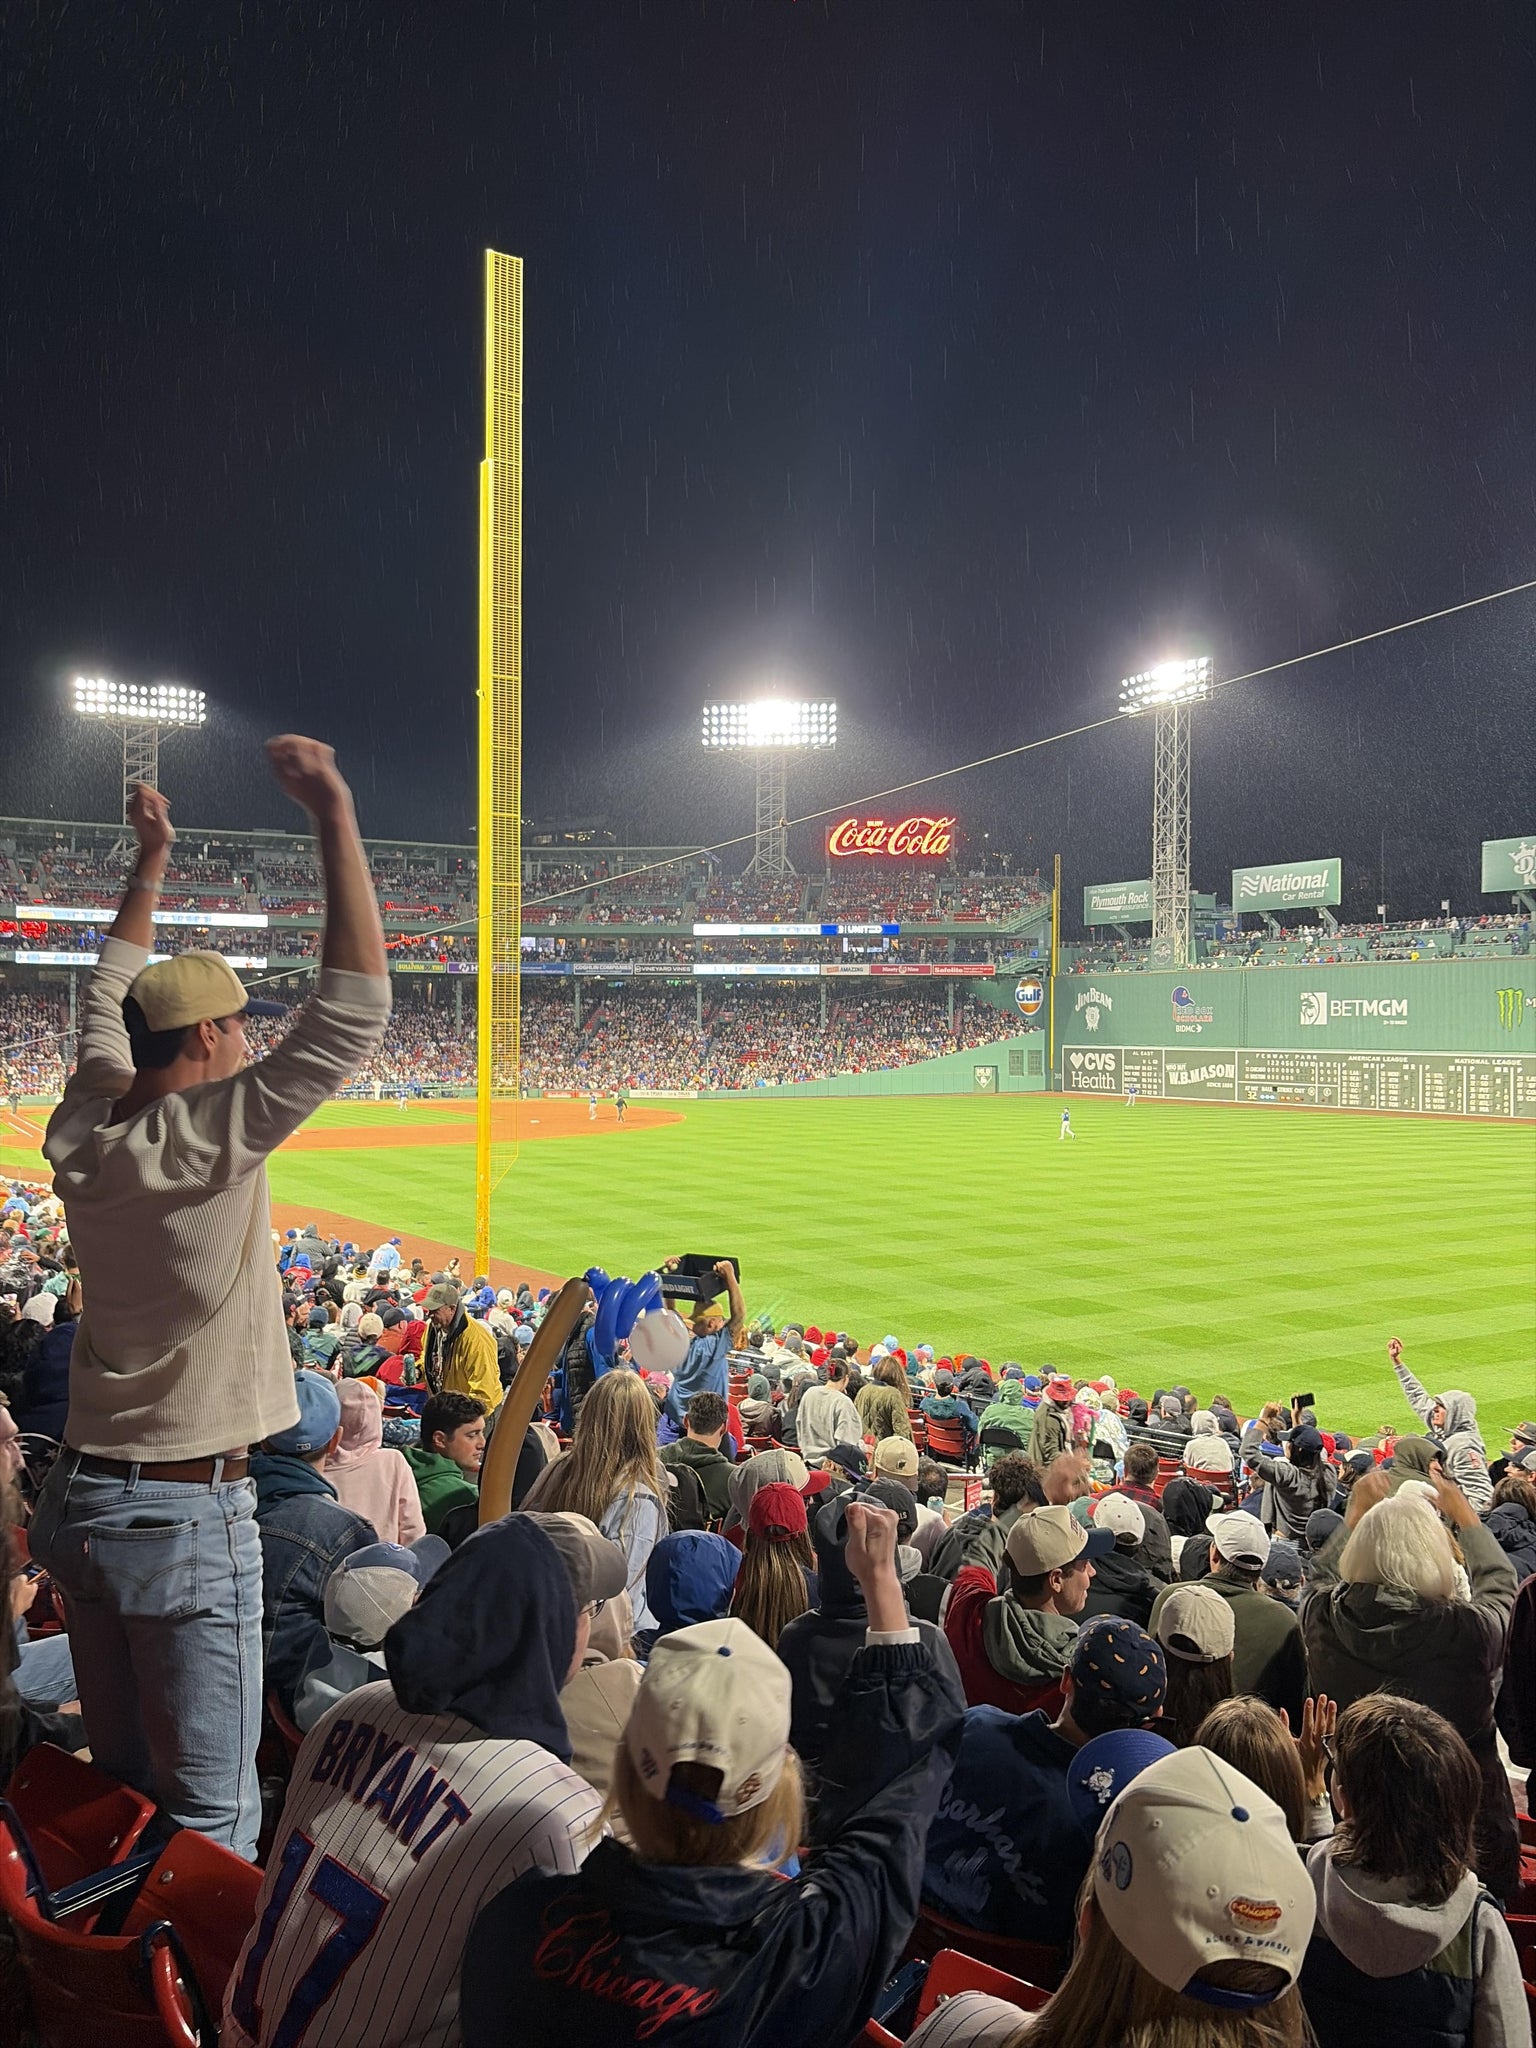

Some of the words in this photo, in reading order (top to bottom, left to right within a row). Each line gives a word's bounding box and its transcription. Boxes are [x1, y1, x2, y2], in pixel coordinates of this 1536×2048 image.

[829, 817, 956, 856] Coca-Cola
[1091, 893, 1126, 908] Plymouth
[1128, 891, 1148, 904] Rock
[1282, 892, 1296, 900] Car
[1298, 890, 1324, 900] Rental
[1016, 989, 1042, 1002] Gulf
[1075, 991, 1090, 1012] JIM
[1090, 988, 1112, 1012] BEAM
[1176, 1006, 1194, 1014] RED
[1195, 1006, 1214, 1014] SOX
[1330, 1000, 1408, 1016] BETMGM
[1176, 1024, 1196, 1032] BIDMC
[1085, 1052, 1116, 1071] CVS
[1072, 1071, 1116, 1090] Health
[1169, 1064, 1234, 1084] W.B.MASON
[1247, 1091, 1257, 1100] 32
[675, 1284, 695, 1294] LIGHT
[309, 1719, 472, 1862] BRYANT
[231, 1828, 389, 2048] 17
[533, 1894, 721, 2040] Chicago
